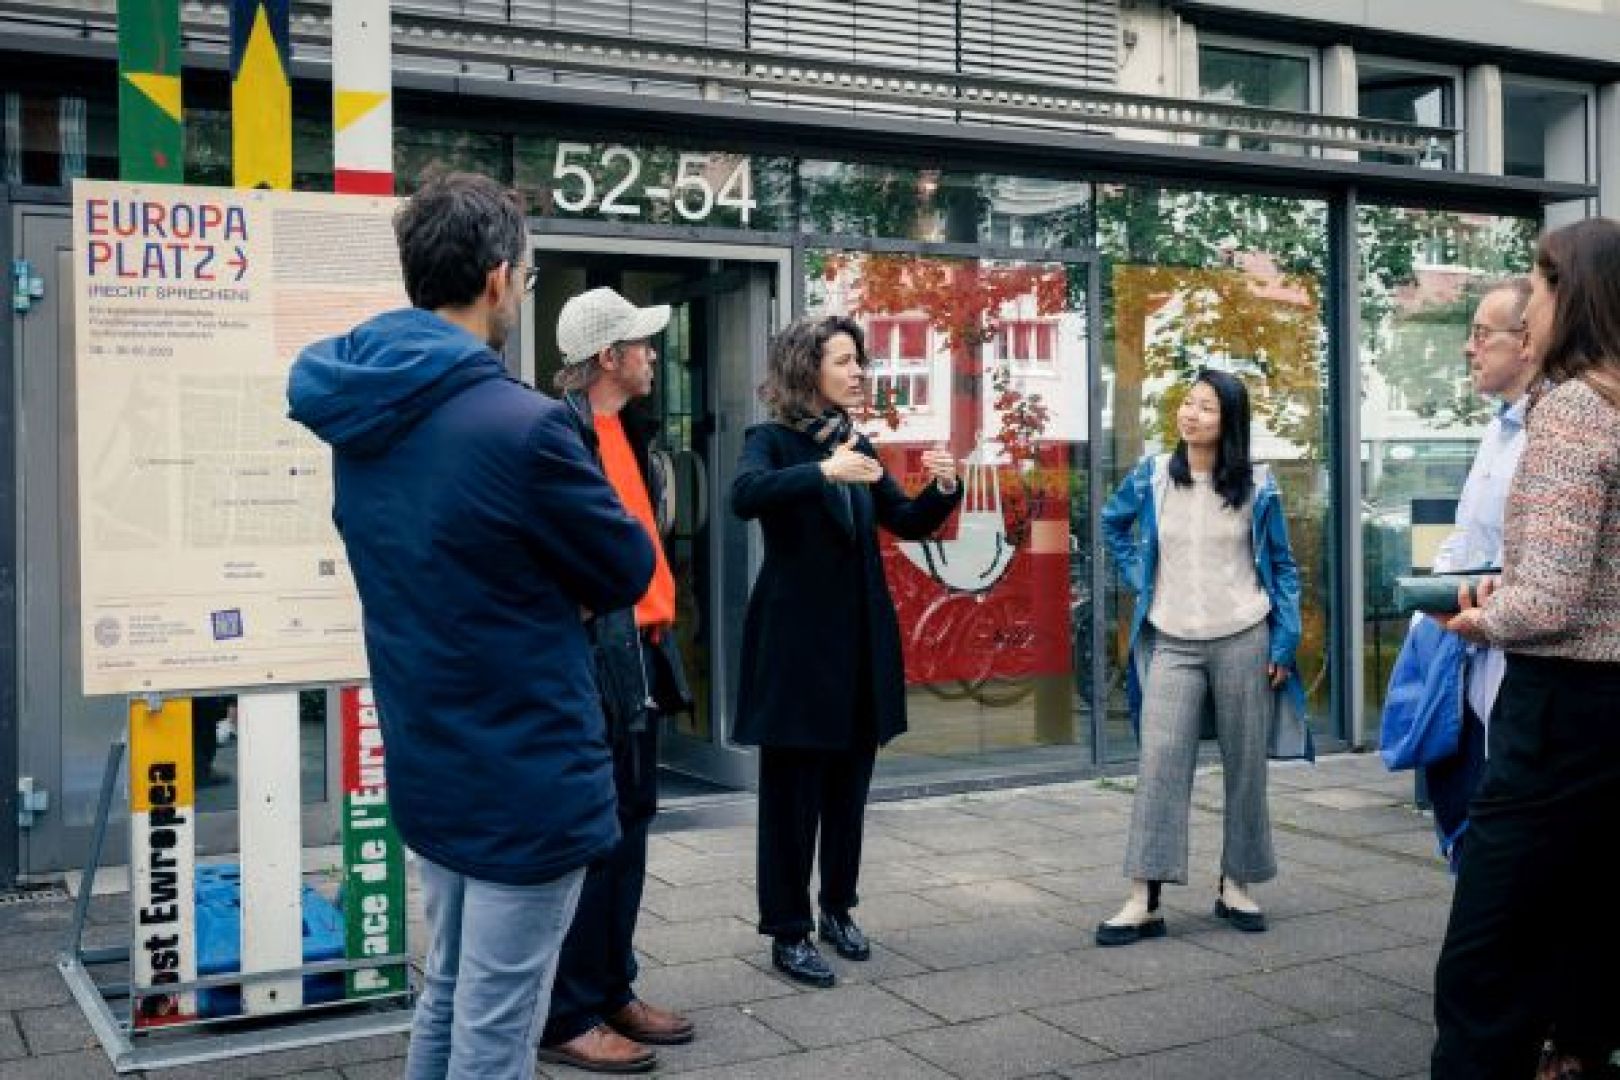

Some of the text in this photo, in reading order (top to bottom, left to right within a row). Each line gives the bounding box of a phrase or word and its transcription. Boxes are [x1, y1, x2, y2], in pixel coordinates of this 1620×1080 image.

[552, 142, 757, 223] 52-54
[87, 199, 248, 241] EUROPA
[88, 242, 216, 280] PLATZ
[351, 839, 387, 883] de
[354, 894, 389, 990] Pace
